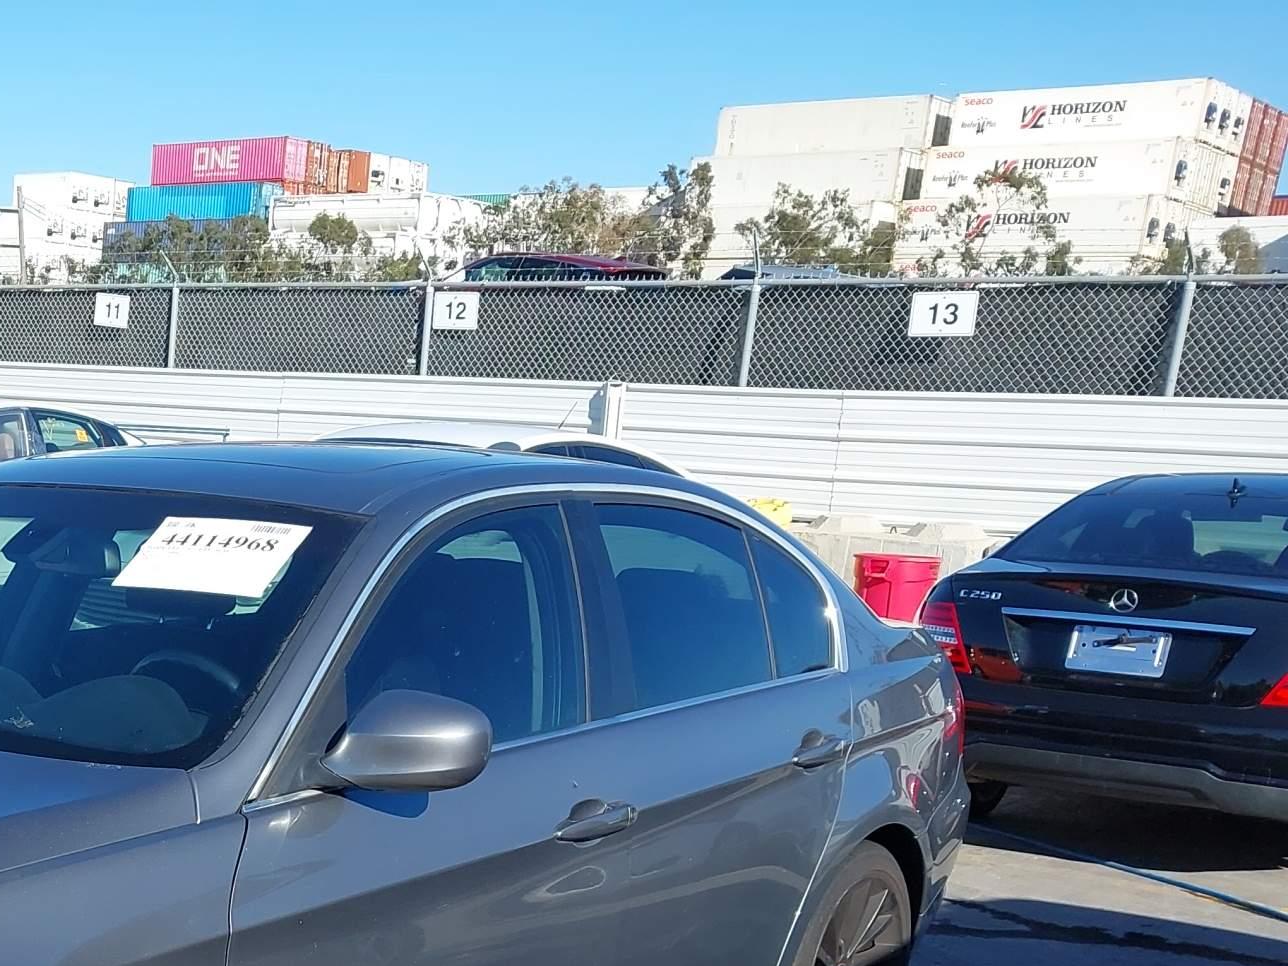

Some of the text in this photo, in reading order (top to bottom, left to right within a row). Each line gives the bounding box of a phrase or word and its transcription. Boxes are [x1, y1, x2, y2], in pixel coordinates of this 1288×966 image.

[1050, 100, 1128, 115] HORIZON
[1048, 115, 1113, 125] LINES
[193, 145, 241, 170] ONE
[936, 151, 965, 159] seaco
[1022, 156, 1098, 169] HORIZON
[106, 302, 120, 319] 11
[445, 302, 467, 320] 12
[929, 303, 959, 325] 13
[162, 533, 279, 552] 44114968
